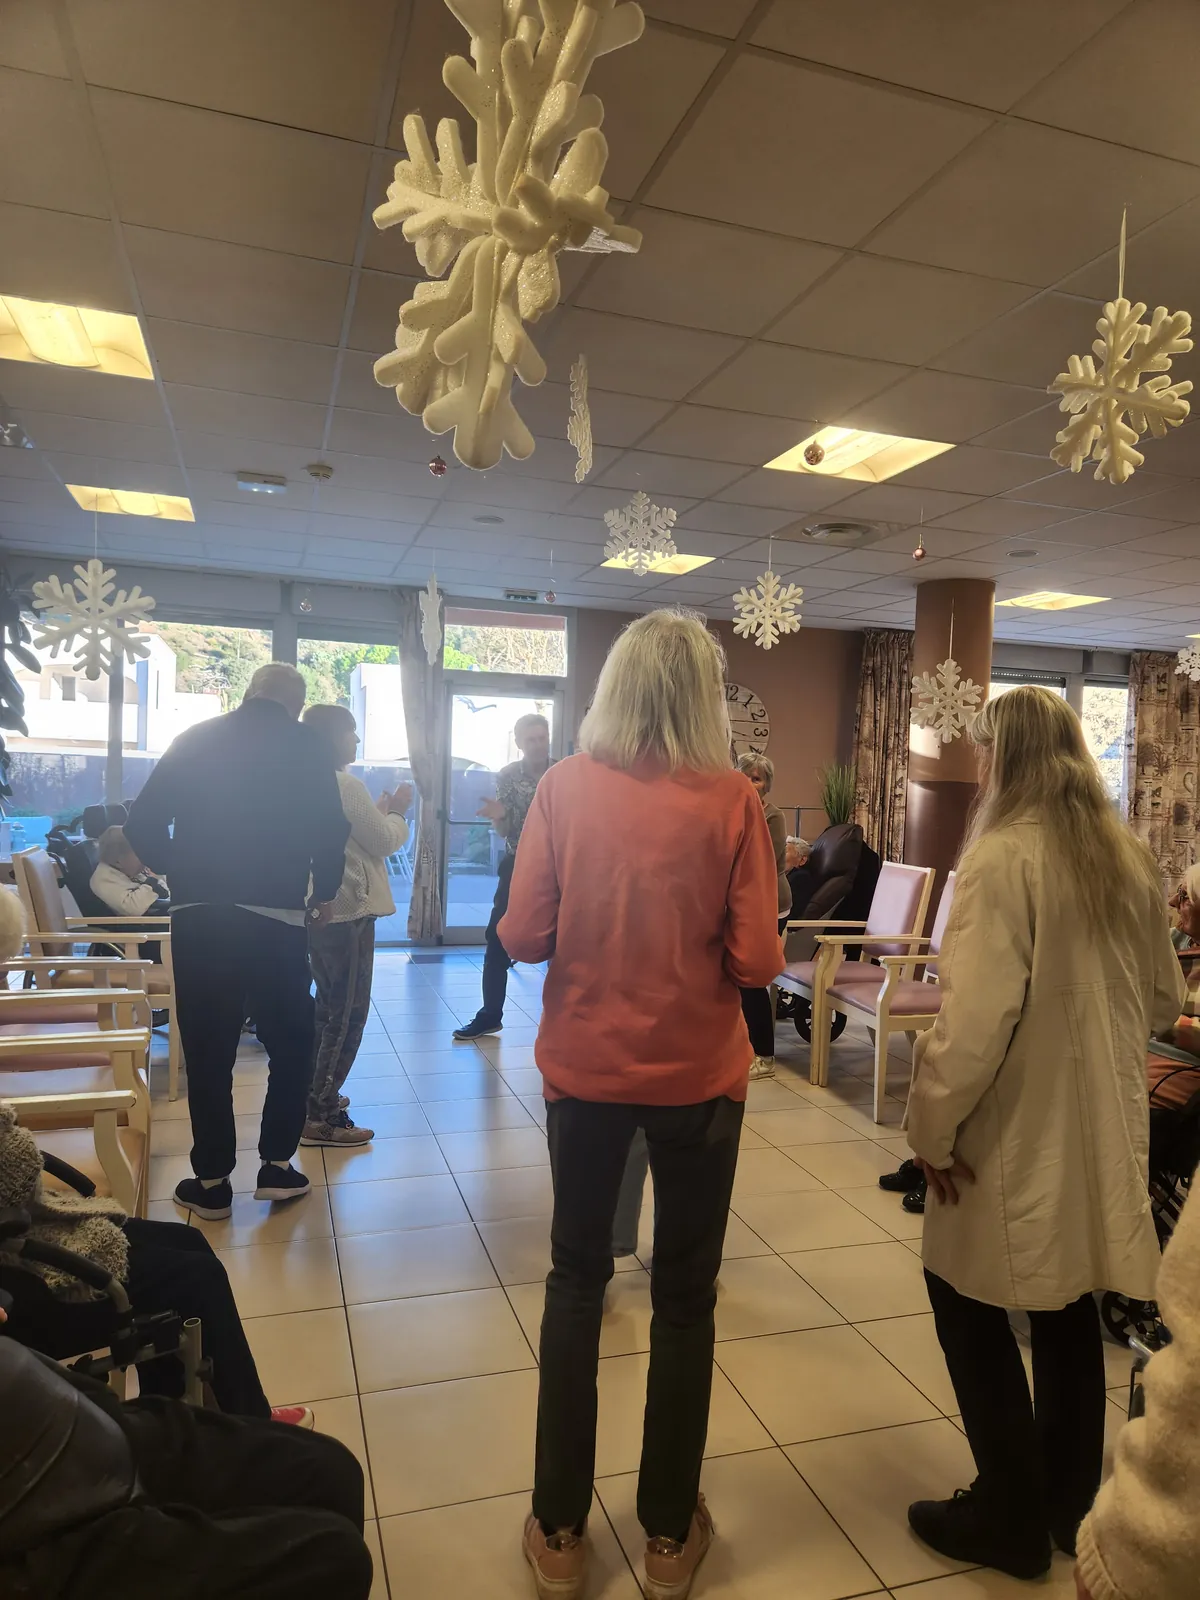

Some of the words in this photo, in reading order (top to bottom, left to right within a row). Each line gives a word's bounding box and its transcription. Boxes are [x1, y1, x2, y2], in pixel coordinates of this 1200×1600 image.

[743, 694, 754, 708] 1
[751, 709, 766, 720] 2
[753, 728, 768, 737] 3
